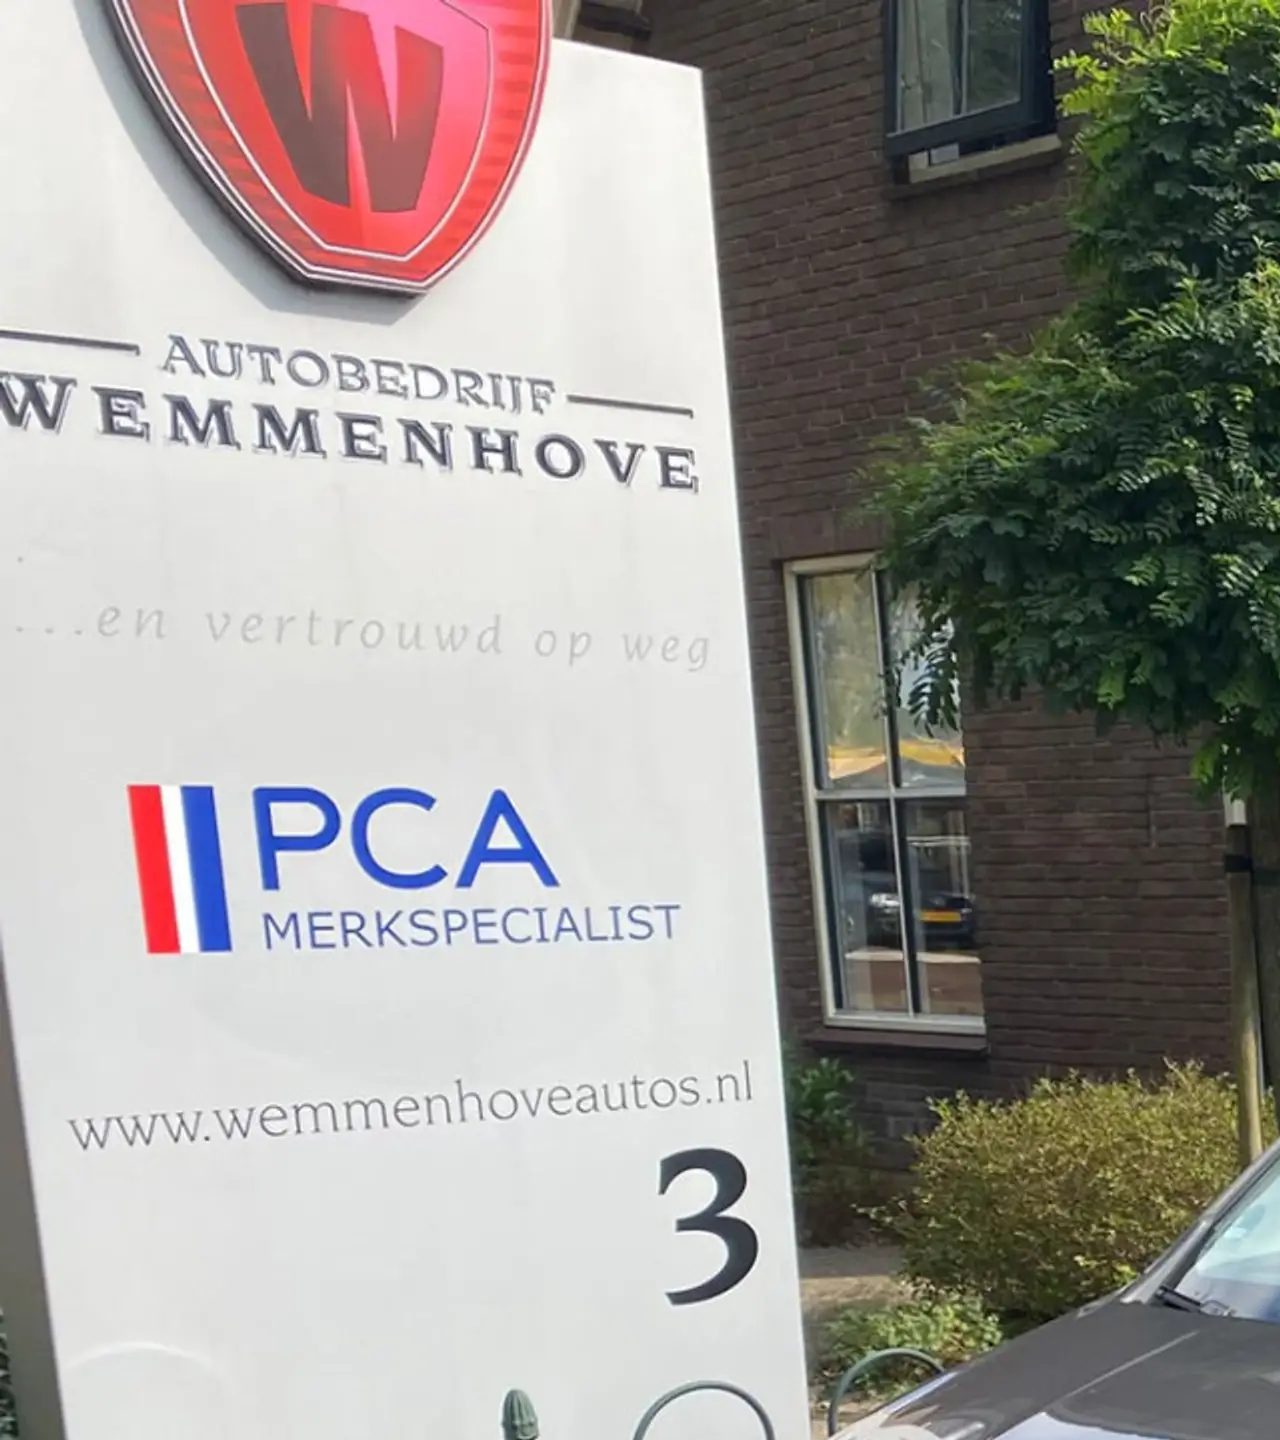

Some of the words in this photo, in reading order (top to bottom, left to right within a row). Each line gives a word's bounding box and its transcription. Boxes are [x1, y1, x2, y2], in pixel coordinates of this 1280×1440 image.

[235, 2, 444, 214] W
[163, 333, 556, 415] AUTOBEDRIJF
[0, 370, 700, 494] WEMMENHOVE
[204, 608, 503, 656] vertrouwd
[533, 629, 594, 668] op
[621, 632, 712, 674] weg
[251, 785, 561, 892] PCA
[261, 903, 682, 952] MERKSPECIALIST
[67, 1058, 754, 1152] www.wemmenhoveautos.nl
[657, 1146, 760, 1307] 3
